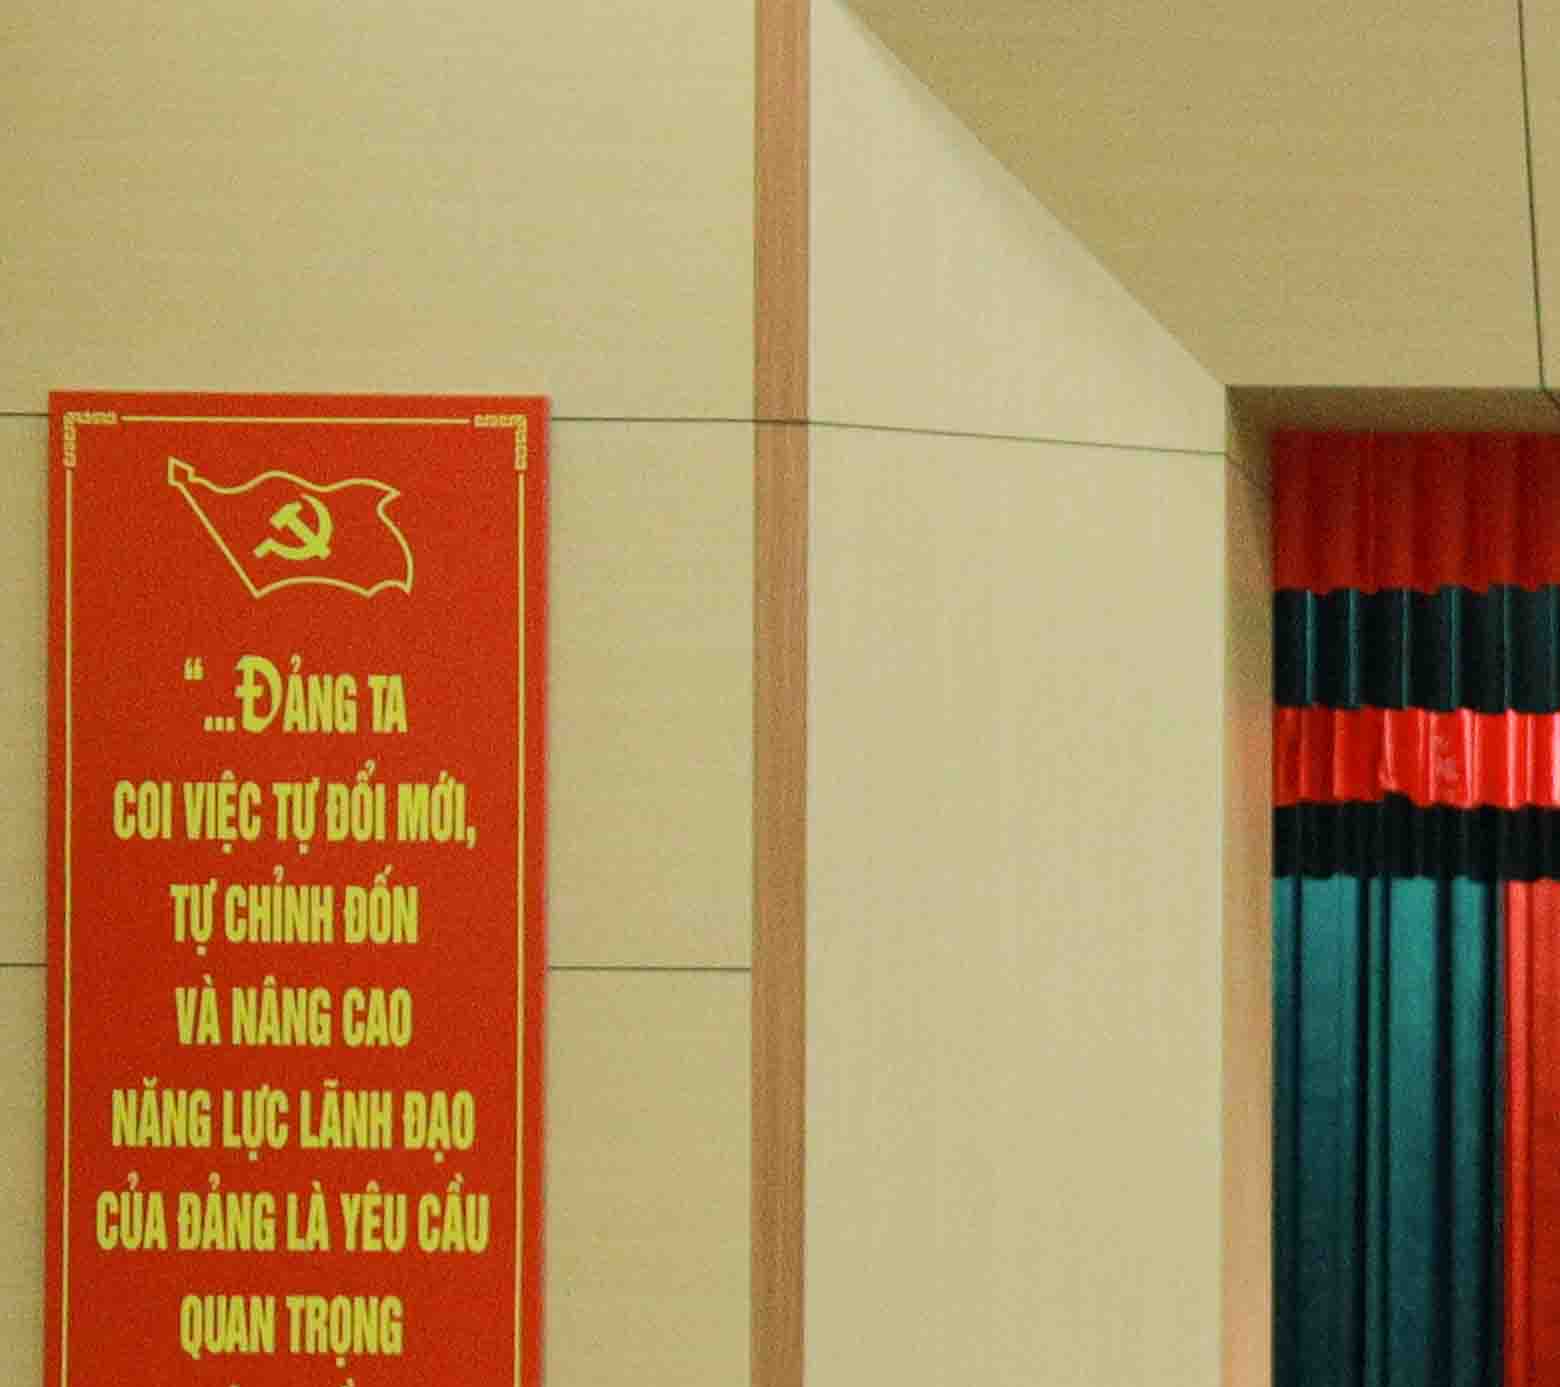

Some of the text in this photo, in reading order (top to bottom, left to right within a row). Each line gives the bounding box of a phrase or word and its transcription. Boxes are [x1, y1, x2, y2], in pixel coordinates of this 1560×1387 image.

[368, 675, 407, 733] TA
[114, 760, 476, 854] COI VIỆC TỰ ĐỔI MỚI,
[176, 975, 412, 1047] VÀ NÂNG CAO
[113, 1078, 475, 1162] NĂNG LỰC LÃNH ĐẠO
[97, 1173, 489, 1253] CỦA ĐẢNG LÀ YÊU CẦU
[181, 1295, 402, 1367] QUAN TRỌNG
